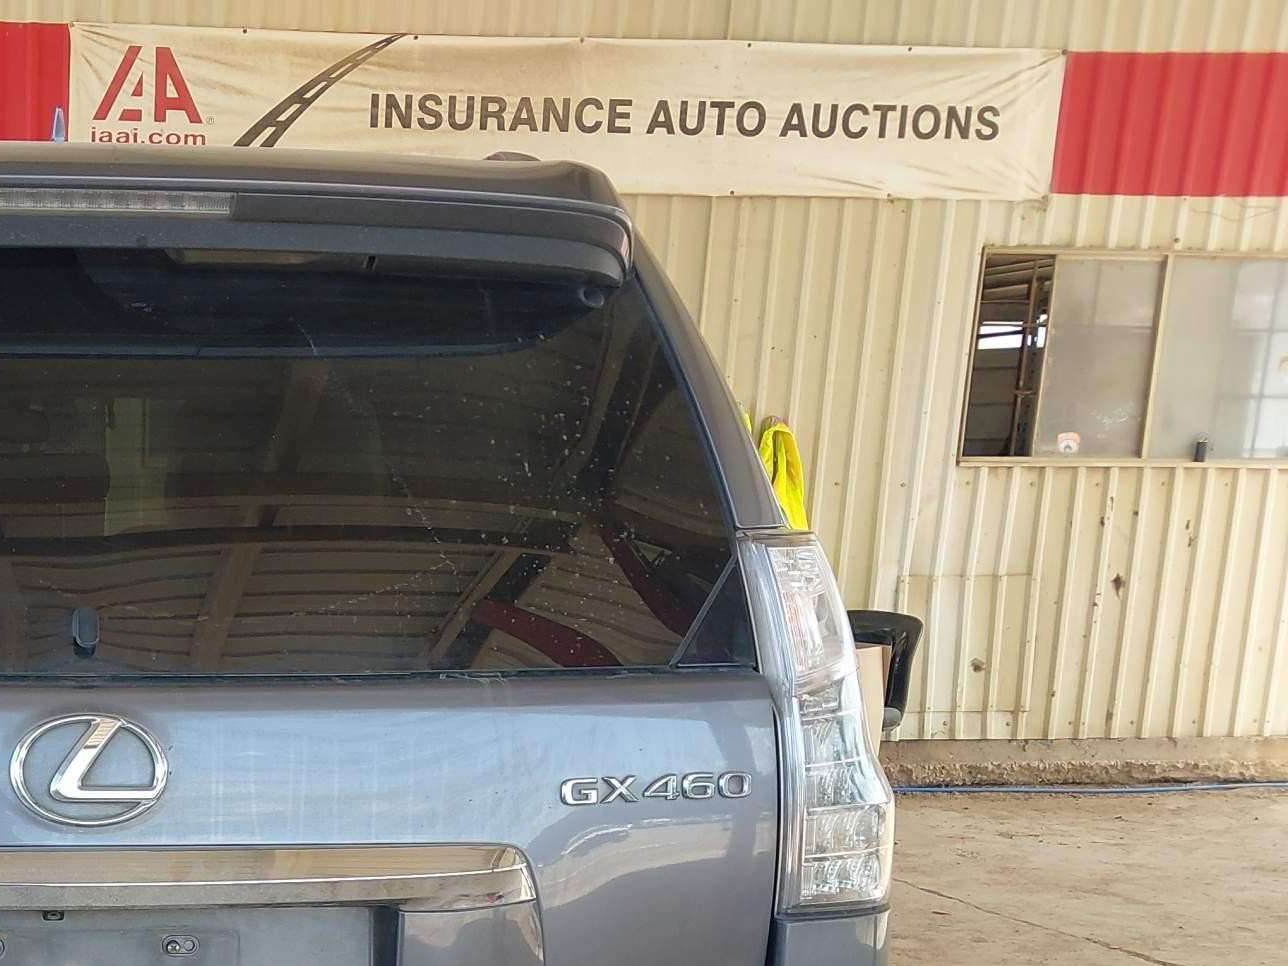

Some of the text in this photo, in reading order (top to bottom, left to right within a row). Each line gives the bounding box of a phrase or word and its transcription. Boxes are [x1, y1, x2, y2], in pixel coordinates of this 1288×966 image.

[369, 93, 1001, 141] INSURANCE AUTO AUCTIONS
[91, 126, 207, 146] iaai.com
